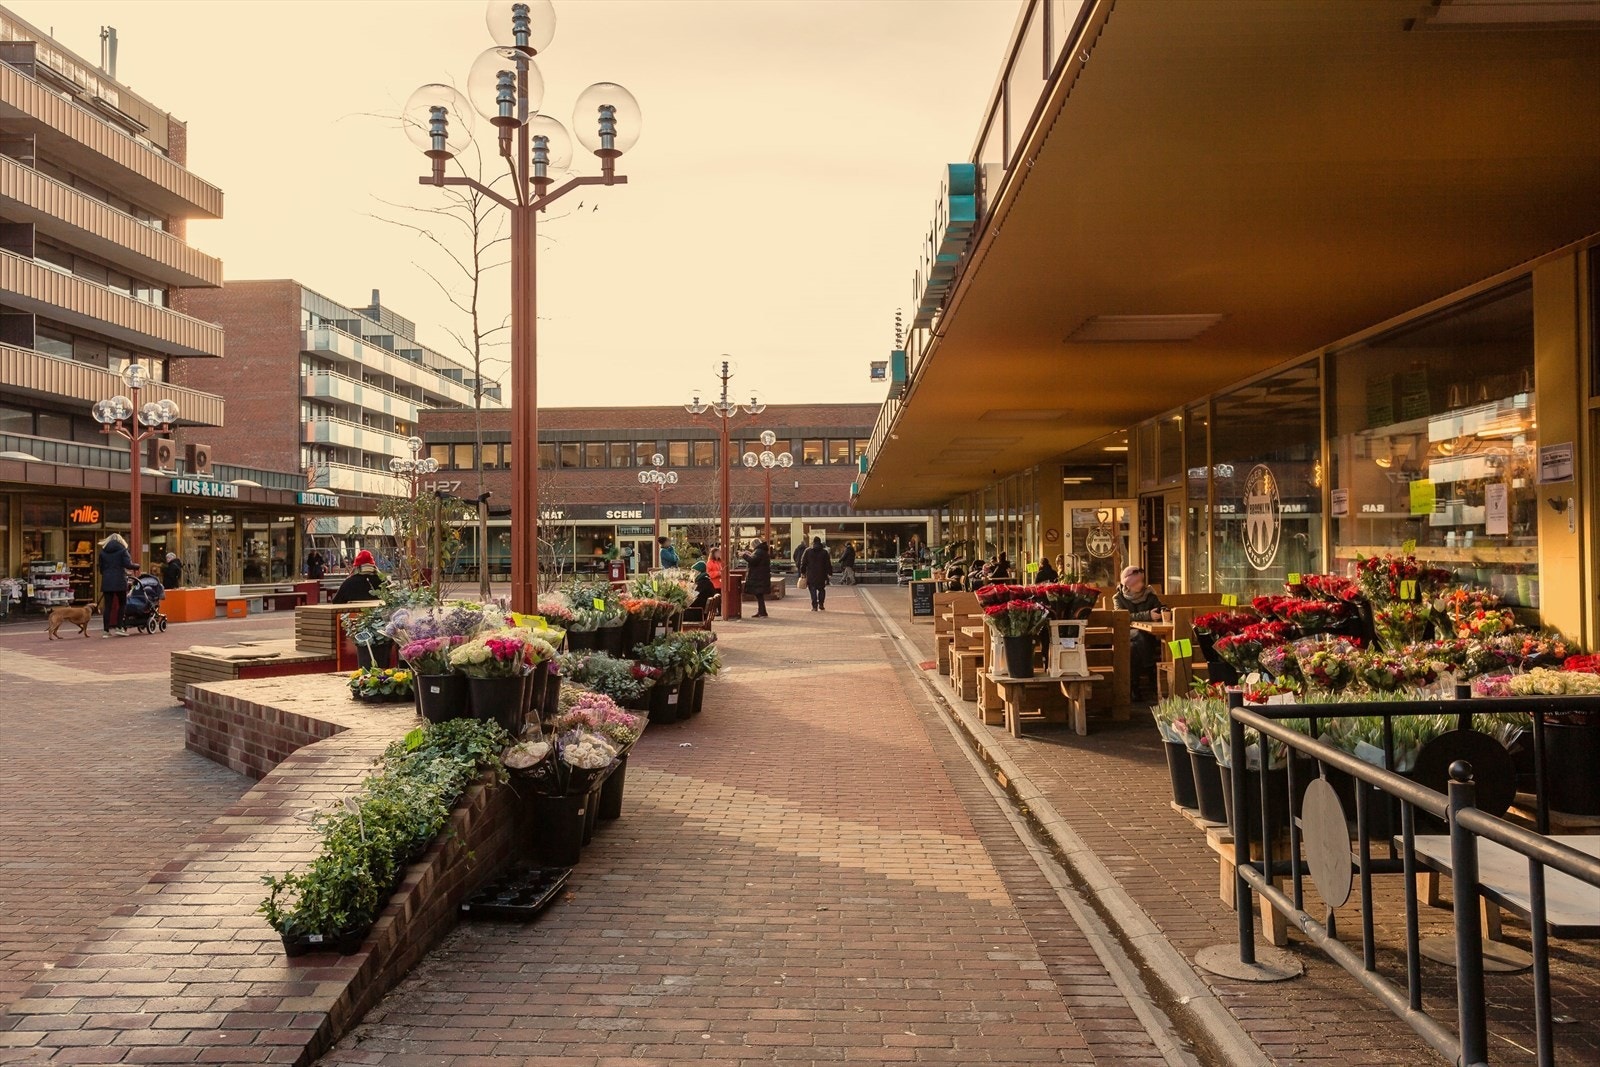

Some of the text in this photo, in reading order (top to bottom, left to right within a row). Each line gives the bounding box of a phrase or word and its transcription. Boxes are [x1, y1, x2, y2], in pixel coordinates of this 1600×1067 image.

[177, 479, 239, 499] HUS & HJEM
[424, 481, 461, 492] H27
[302, 492, 340, 507] BIBLIOTEK
[71, 505, 99, 523] nille
[606, 510, 642, 519] SCENE
